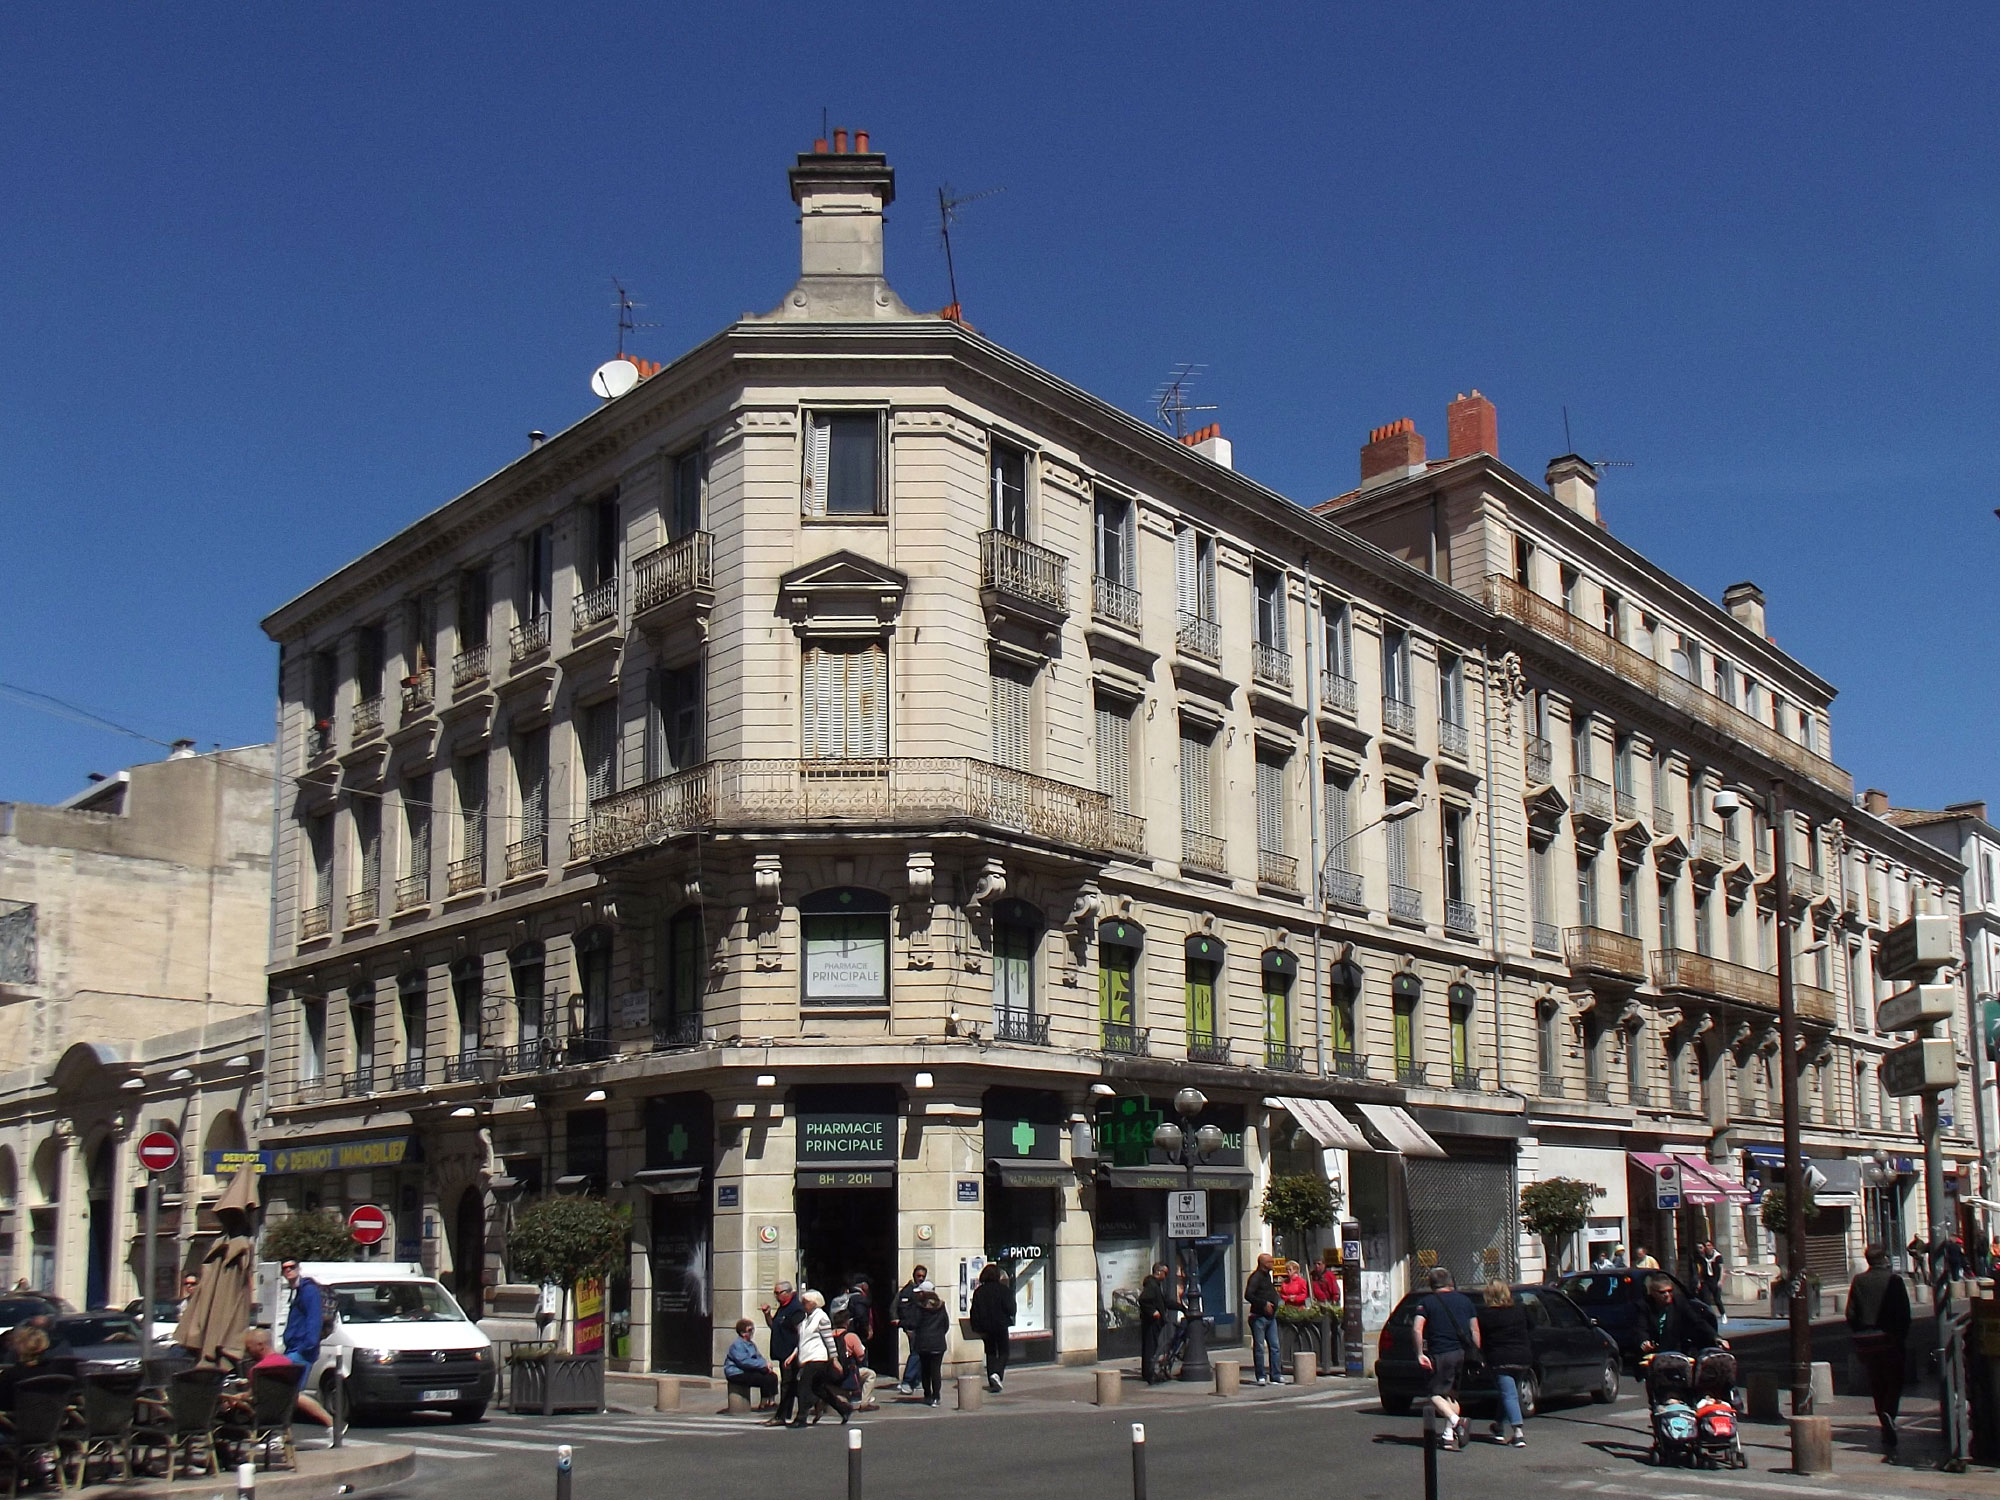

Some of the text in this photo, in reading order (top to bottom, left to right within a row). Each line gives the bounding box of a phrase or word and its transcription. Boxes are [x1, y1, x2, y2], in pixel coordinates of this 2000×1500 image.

[824, 962, 868, 970] PHARMACIE
[812, 971, 880, 982] PRINCIPALE
[806, 1122, 883, 1135] PHARMACIE
[806, 1138, 884, 1152] PRINCIPALE
[215, 1163, 267, 1173] IMMOIER
[819, 1174, 835, 1185] 8H
[847, 1173, 872, 1184] 20H
[1010, 1246, 1041, 1258] PHYTO
